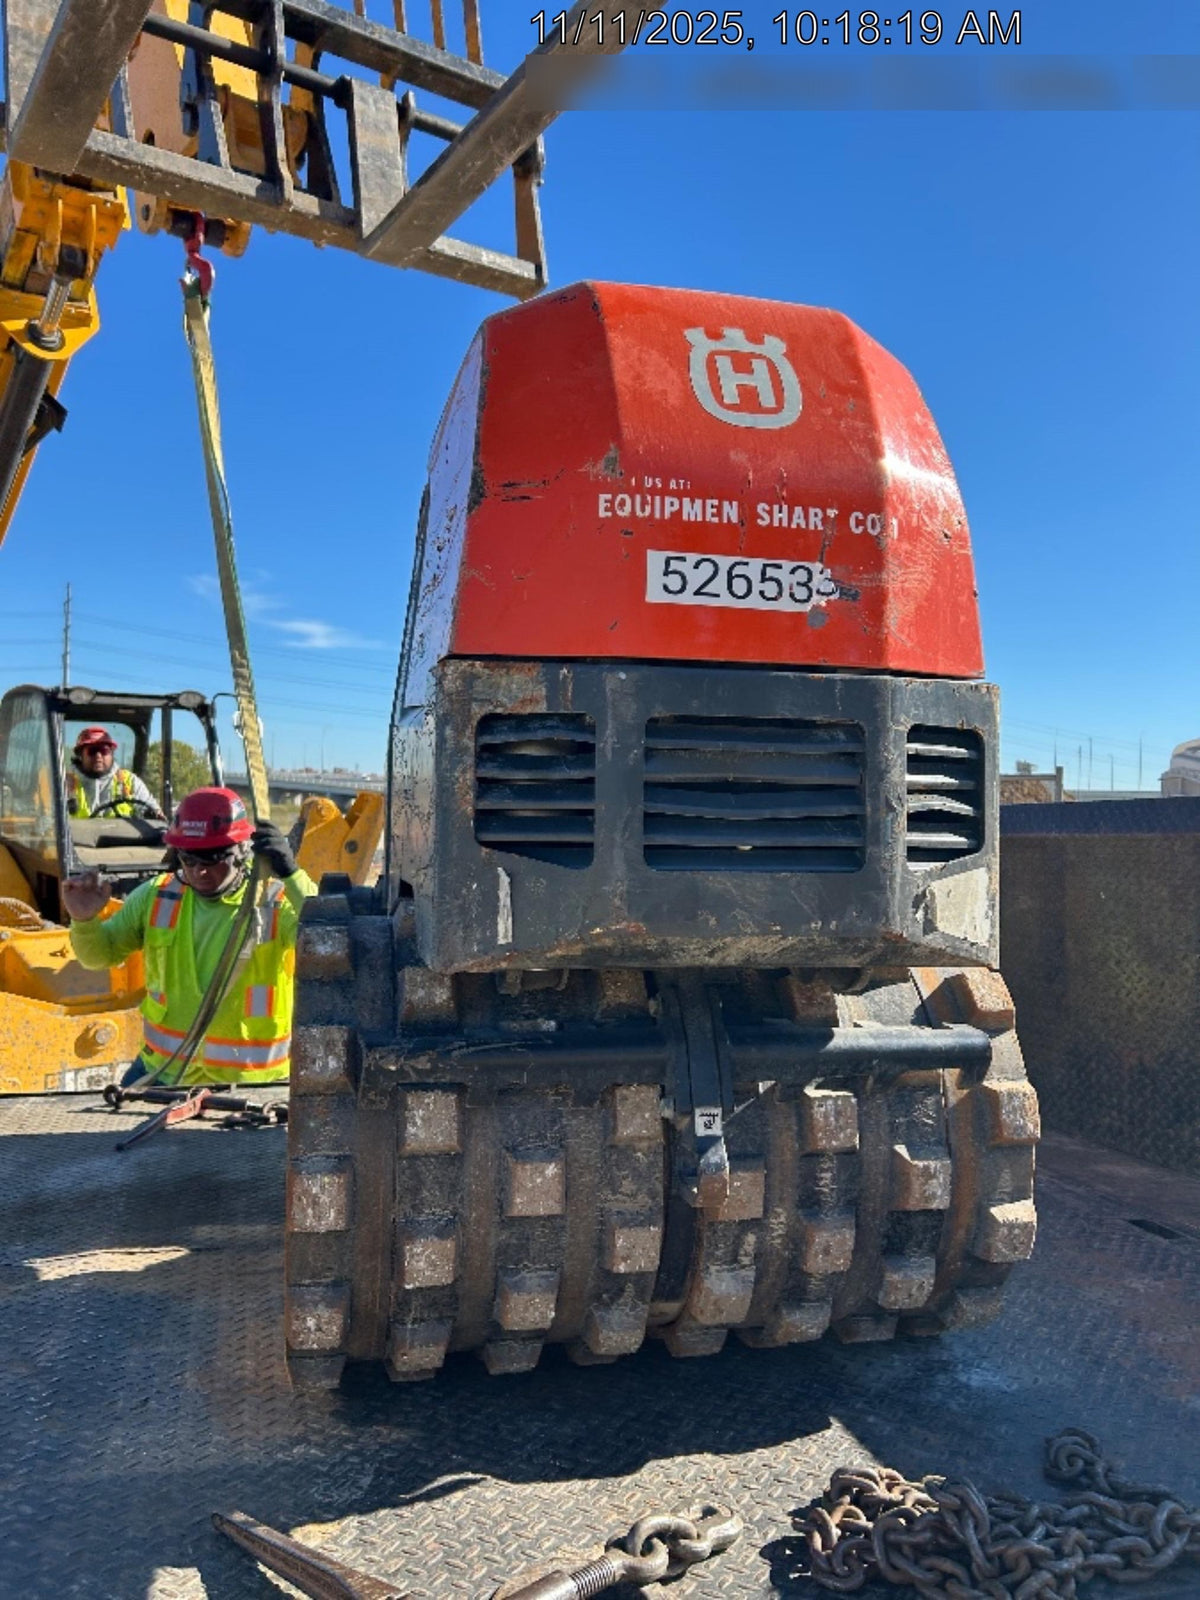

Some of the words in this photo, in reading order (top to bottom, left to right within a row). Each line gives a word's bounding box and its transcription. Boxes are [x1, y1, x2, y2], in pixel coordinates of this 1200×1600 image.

[644, 475, 662, 489] US
[756, 502, 839, 531] SHAR
[849, 511, 899, 540] CO
